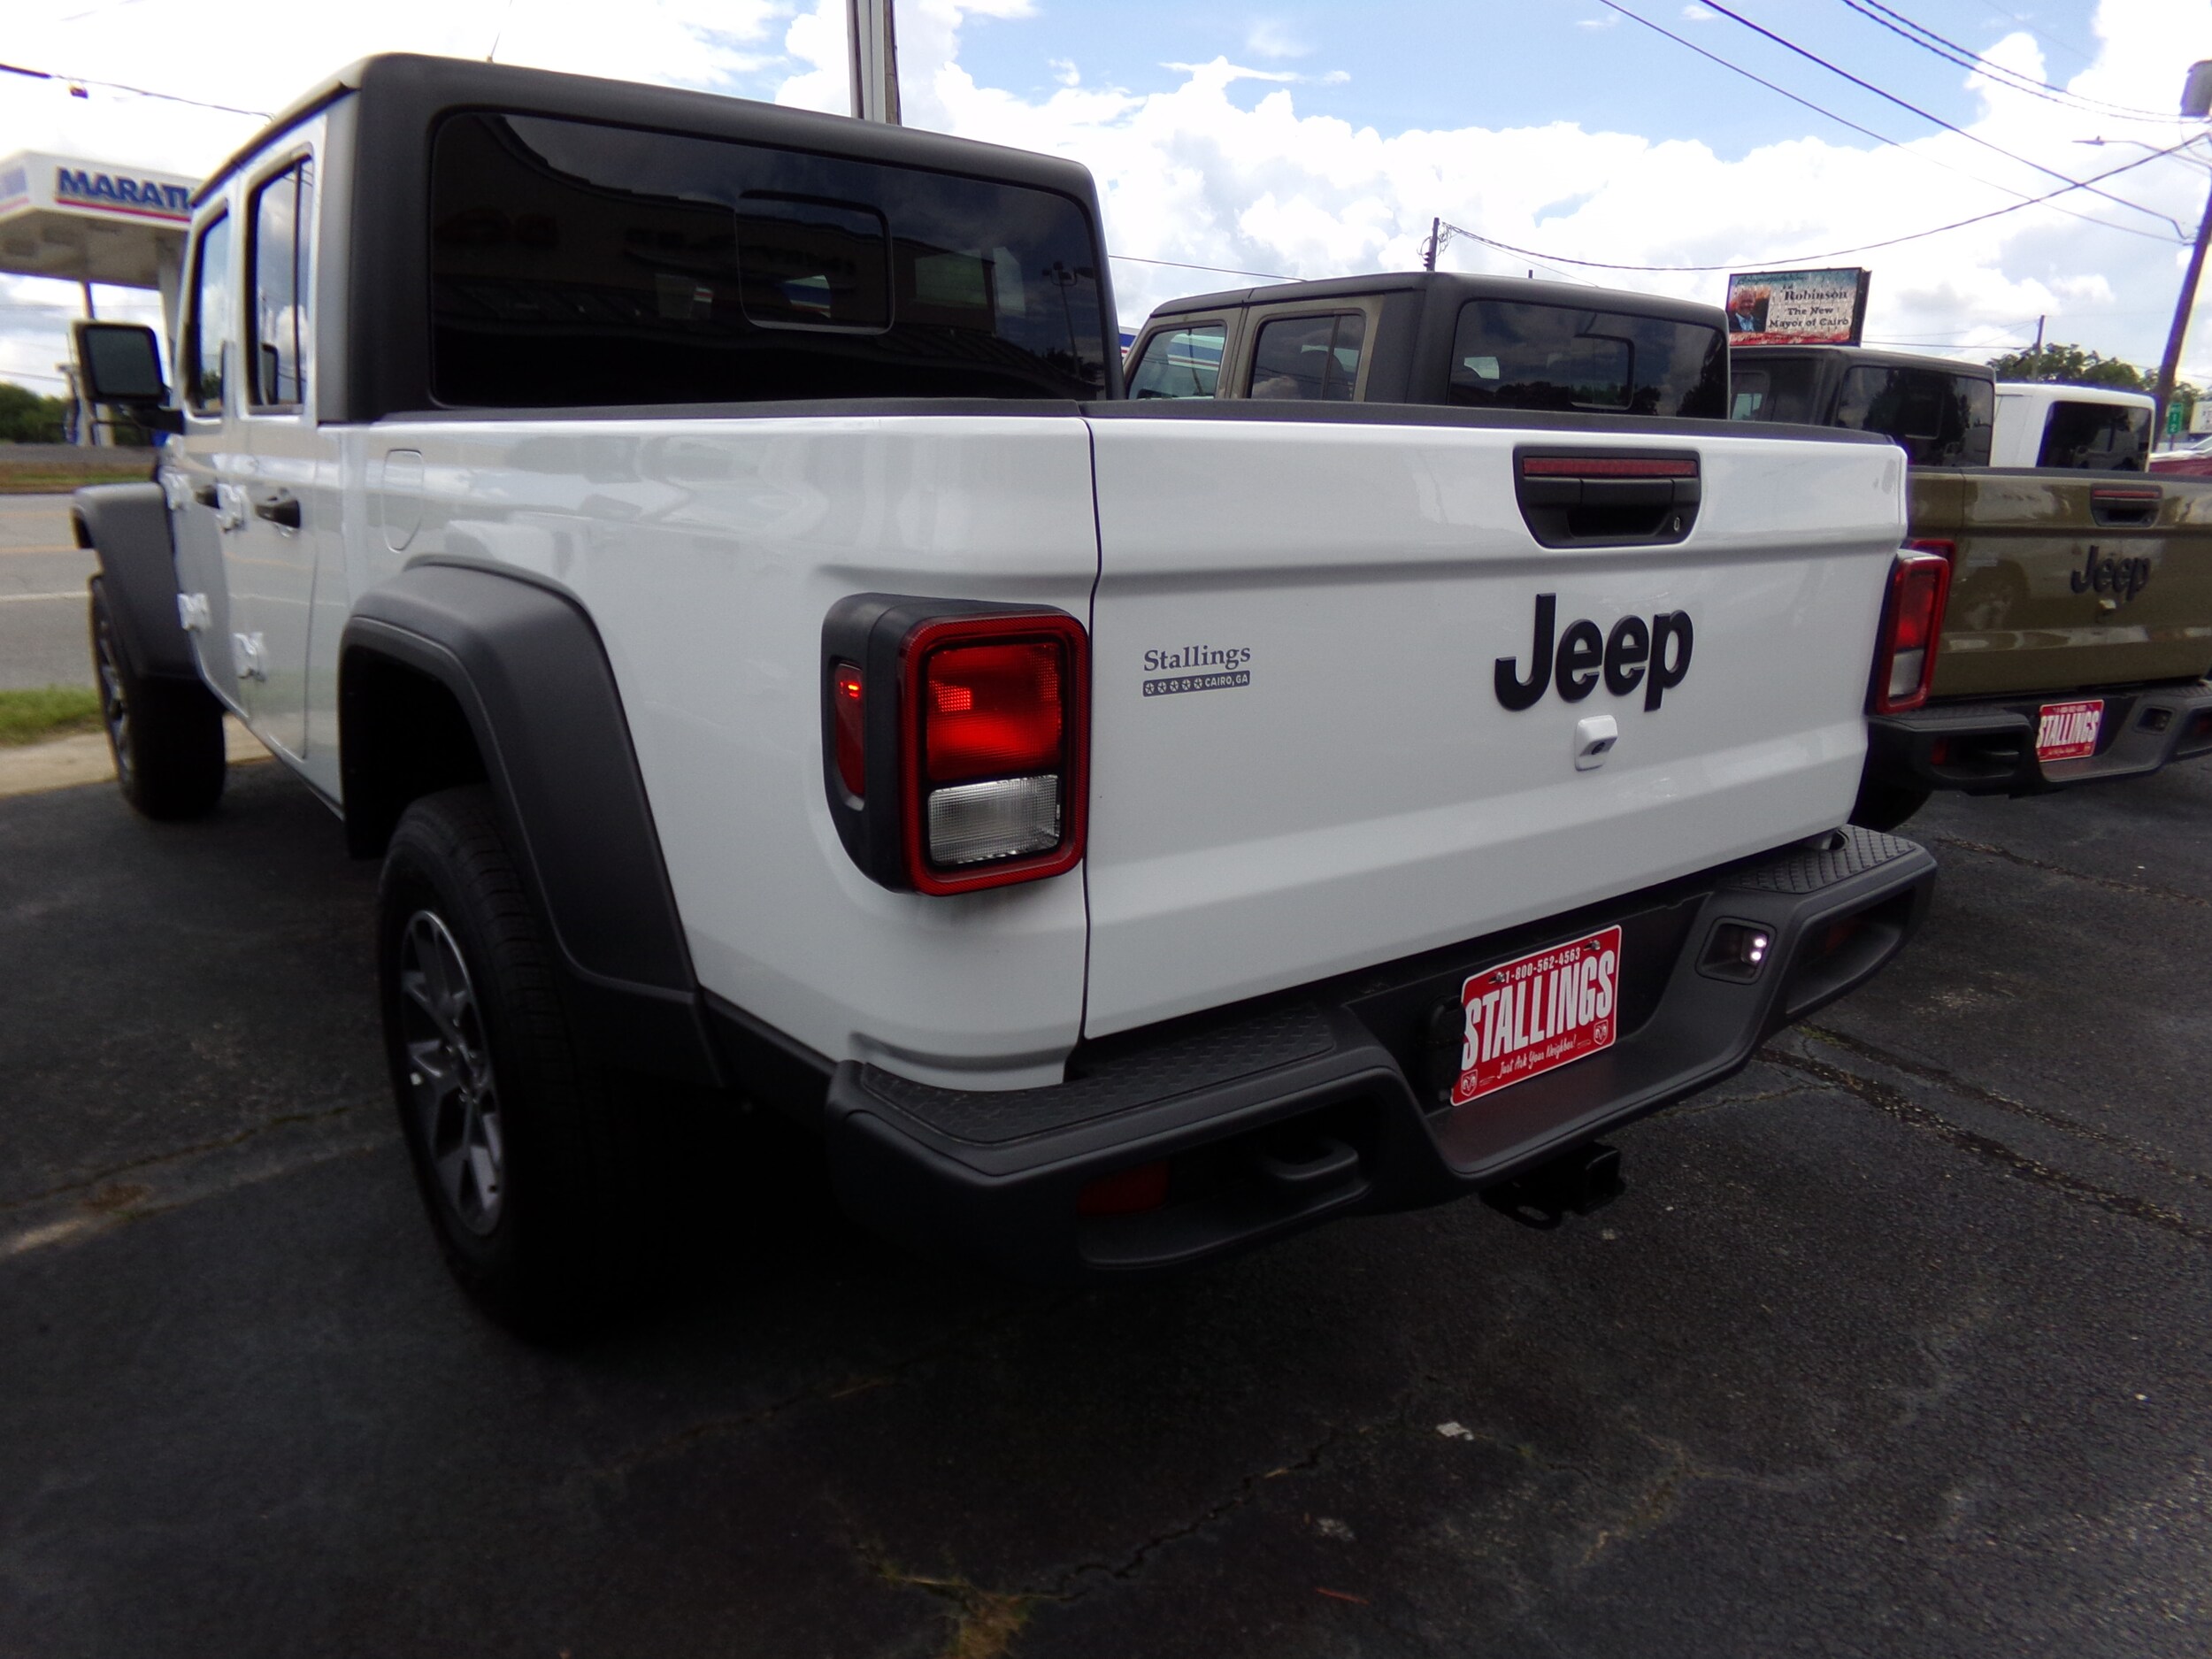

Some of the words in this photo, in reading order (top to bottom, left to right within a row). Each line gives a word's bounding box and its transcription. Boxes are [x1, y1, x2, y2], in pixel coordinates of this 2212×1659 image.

[1784, 289, 1848, 301] Robinson
[1788, 307, 1808, 316] The
[1809, 306, 1833, 316] New
[1769, 319, 1803, 329] Mayor
[1806, 318, 1816, 326] of
[1819, 318, 1849, 326] Cairo
[2070, 545, 2151, 601] Jeep
[1144, 645, 1251, 672] Stallings
[1494, 592, 1694, 712] Jeep
[2036, 710, 2100, 749] STALLINGS
[1505, 947, 1581, 984] 1-800-562-4563
[1461, 949, 1615, 1071] STALLINGS
[1497, 1058, 1514, 1079] Just
[1514, 1054, 1528, 1071] Ask
[1529, 1050, 1545, 1070] Your
